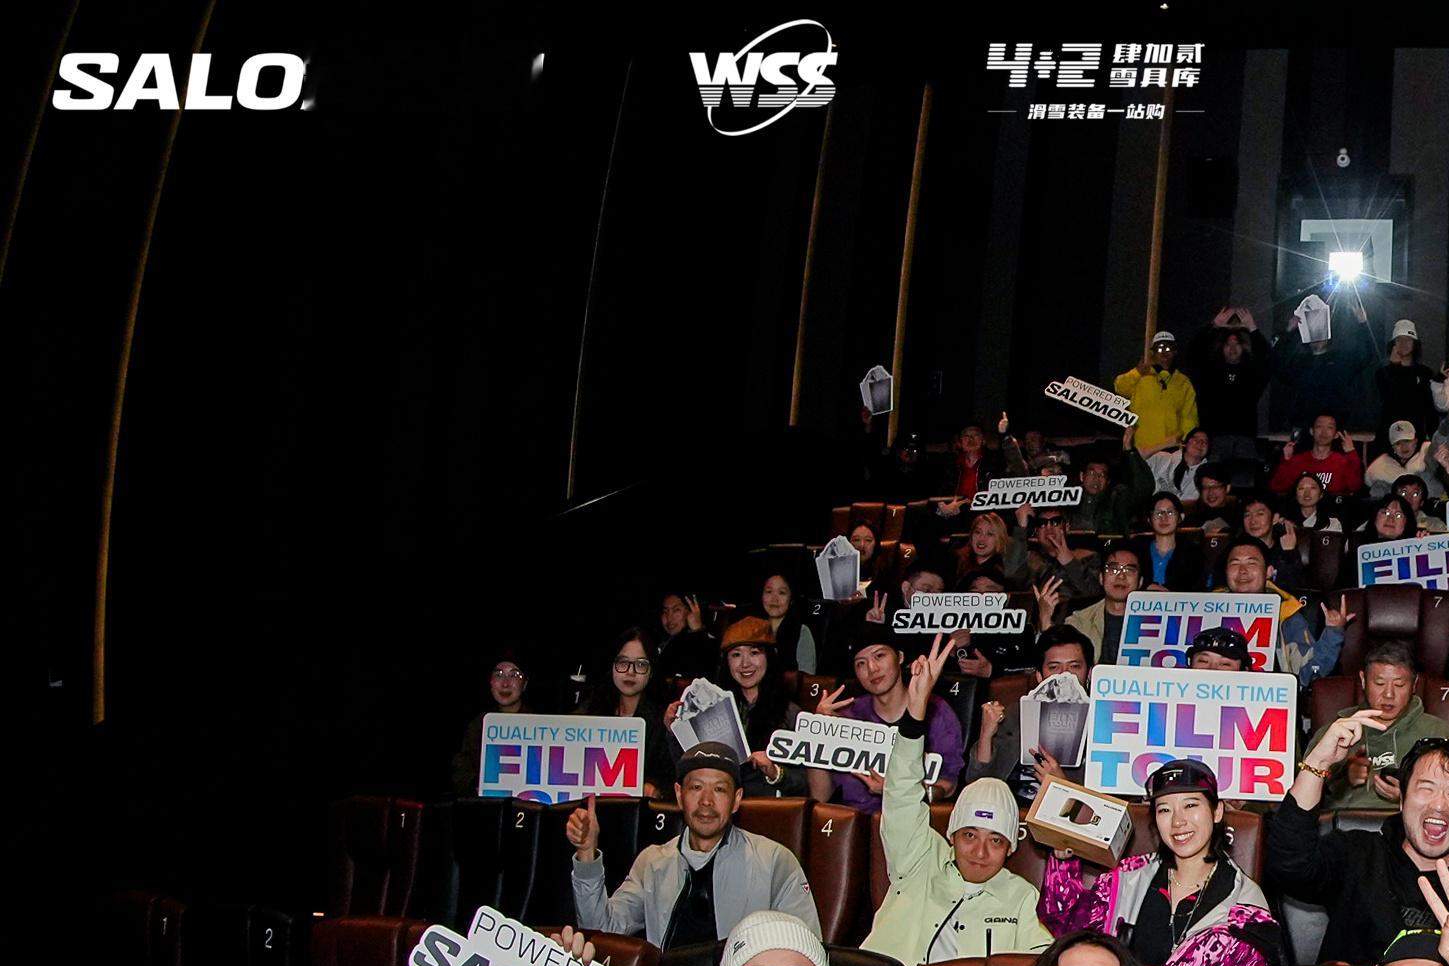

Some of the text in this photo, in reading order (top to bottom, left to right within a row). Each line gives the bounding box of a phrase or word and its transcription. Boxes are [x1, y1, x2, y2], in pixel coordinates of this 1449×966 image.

[1067, 378, 1128, 408] POWERED BY
[1046, 383, 1136, 426] SALOMON
[990, 477, 1065, 490] POWERED BY
[973, 489, 1080, 507] SALOMON
[1209, 537, 1219, 548] 5
[1321, 536, 1330, 546] 6
[903, 548, 912, 559] 2
[1361, 543, 1424, 561] QUALITY
[812, 604, 821, 615] 2
[912, 595, 1003, 607] POWERED BY
[1129, 600, 1274, 614] QUALITY SKI TIME
[1433, 596, 1443, 608] 7
[893, 612, 1023, 629] SALOMON
[809, 683, 819, 697] 3
[949, 681, 960, 696] 4
[1096, 678, 1289, 703] QUALITY SKI TIME
[486, 725, 639, 743] QUALITY SKI TIME
[797, 718, 886, 745] POWERED
[1092, 700, 1289, 753] FILM
[483, 743, 639, 788] FILM
[768, 736, 938, 781] SALOM
[514, 812, 526, 828] 2
[655, 813, 666, 831] 3
[821, 818, 834, 837] 4
[264, 927, 274, 950] 2
